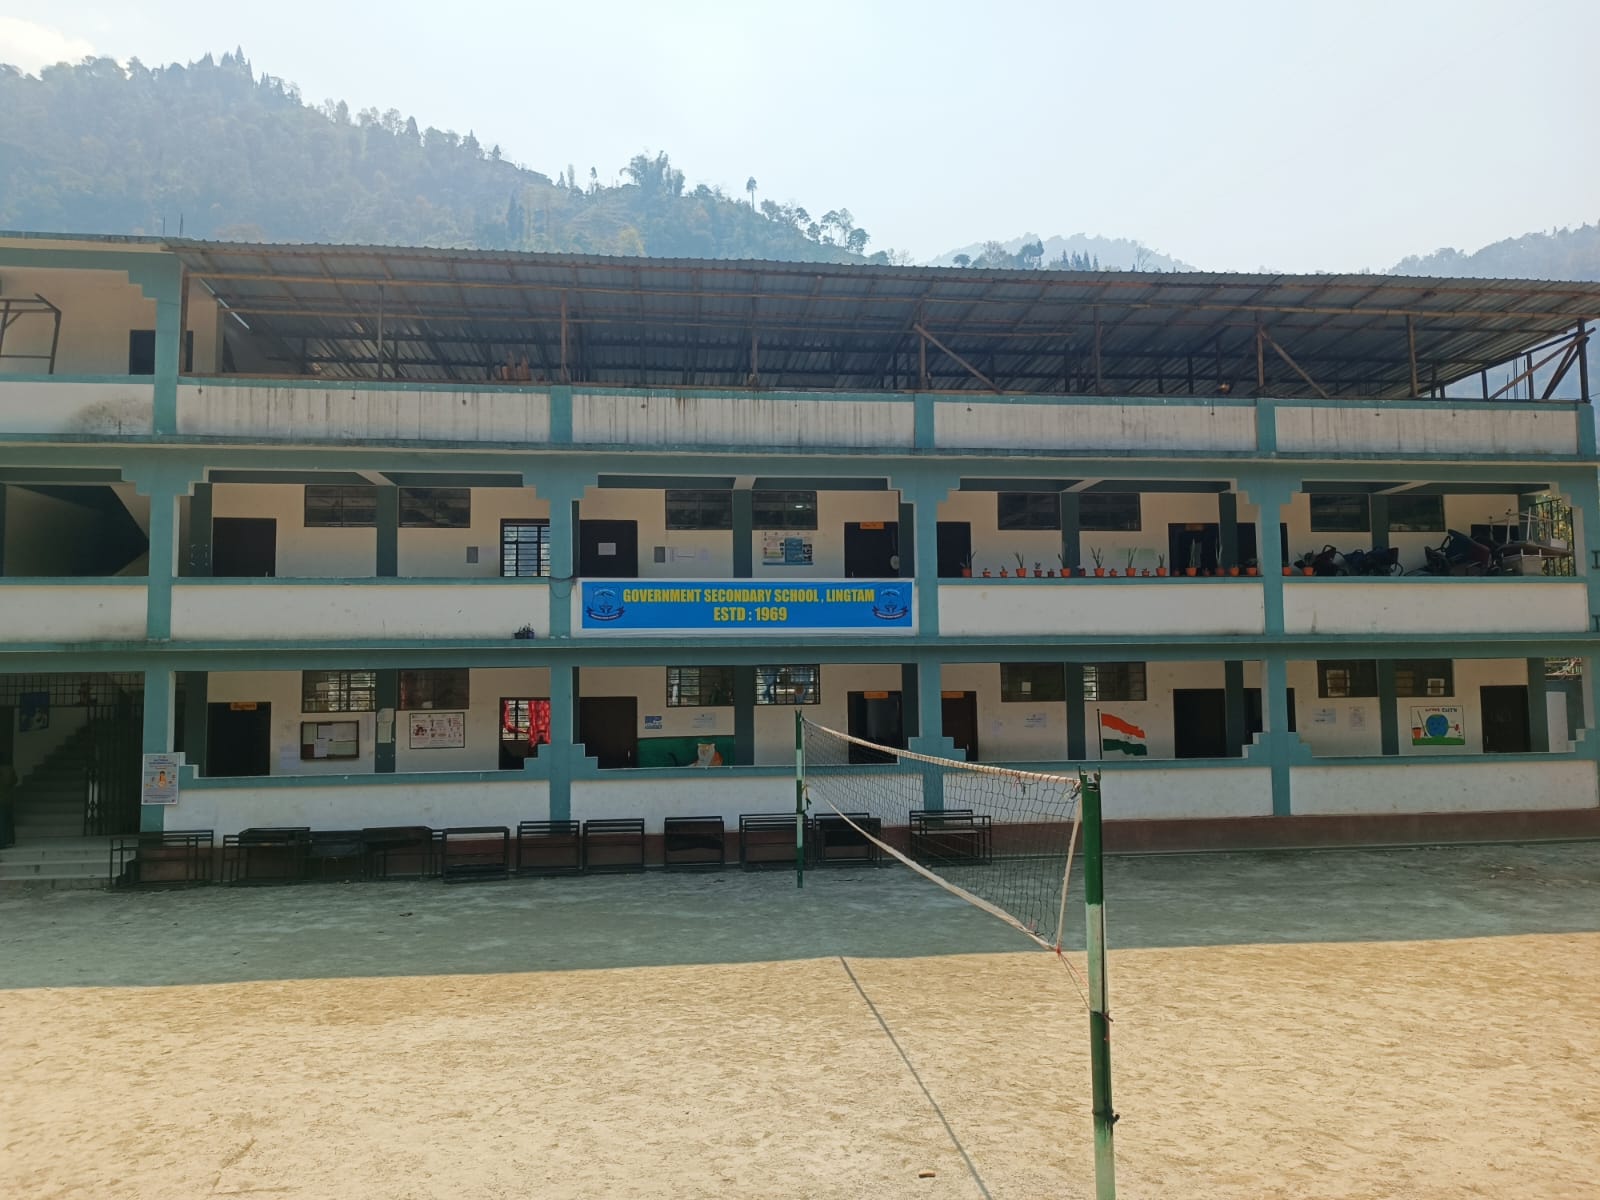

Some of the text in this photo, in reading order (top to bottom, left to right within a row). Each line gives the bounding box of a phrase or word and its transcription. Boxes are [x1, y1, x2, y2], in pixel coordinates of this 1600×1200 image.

[623, 588, 702, 603] GOVERNMENT
[703, 588, 772, 603] SECONDARY
[826, 588, 875, 603] LINGTAM
[754, 606, 788, 621] 1969
